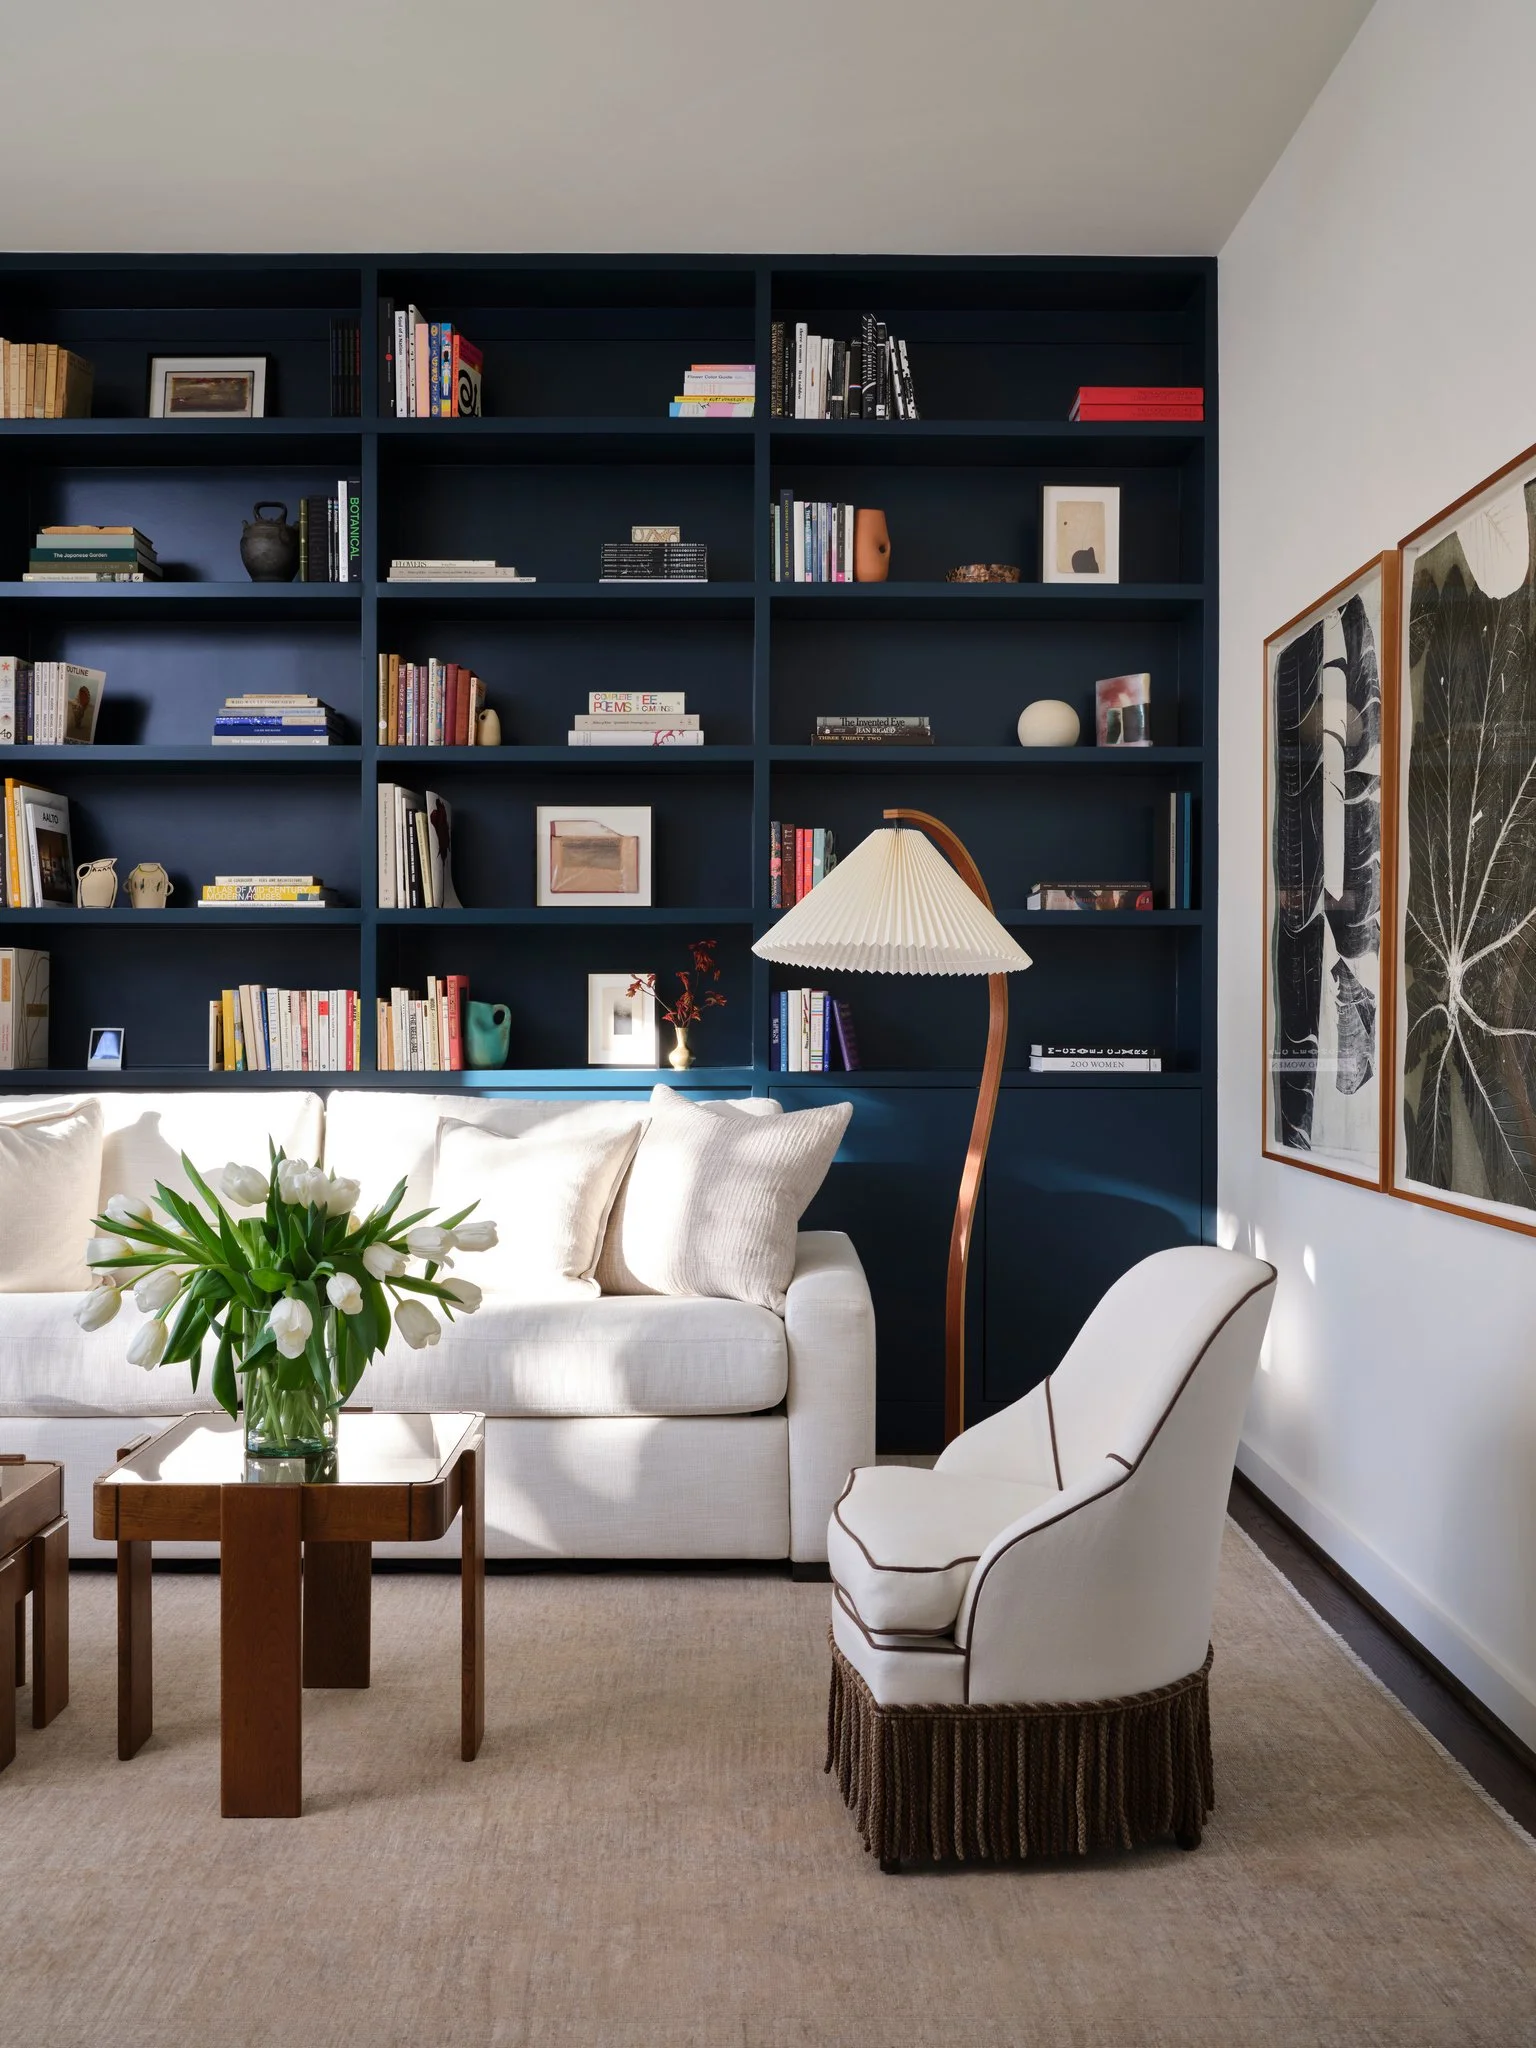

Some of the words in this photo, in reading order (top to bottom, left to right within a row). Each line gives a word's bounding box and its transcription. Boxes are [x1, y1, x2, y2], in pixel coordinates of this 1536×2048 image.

[350, 497, 359, 561] BOTANICAL
[67, 665, 89, 677] OUTLINE
[594, 693, 632, 701] COMPLETE
[593, 701, 632, 712] POEMS
[840, 717, 855, 727] The
[856, 717, 890, 727] Invented
[890, 717, 905, 727] Eye
[42, 812, 59, 824] AALTO
